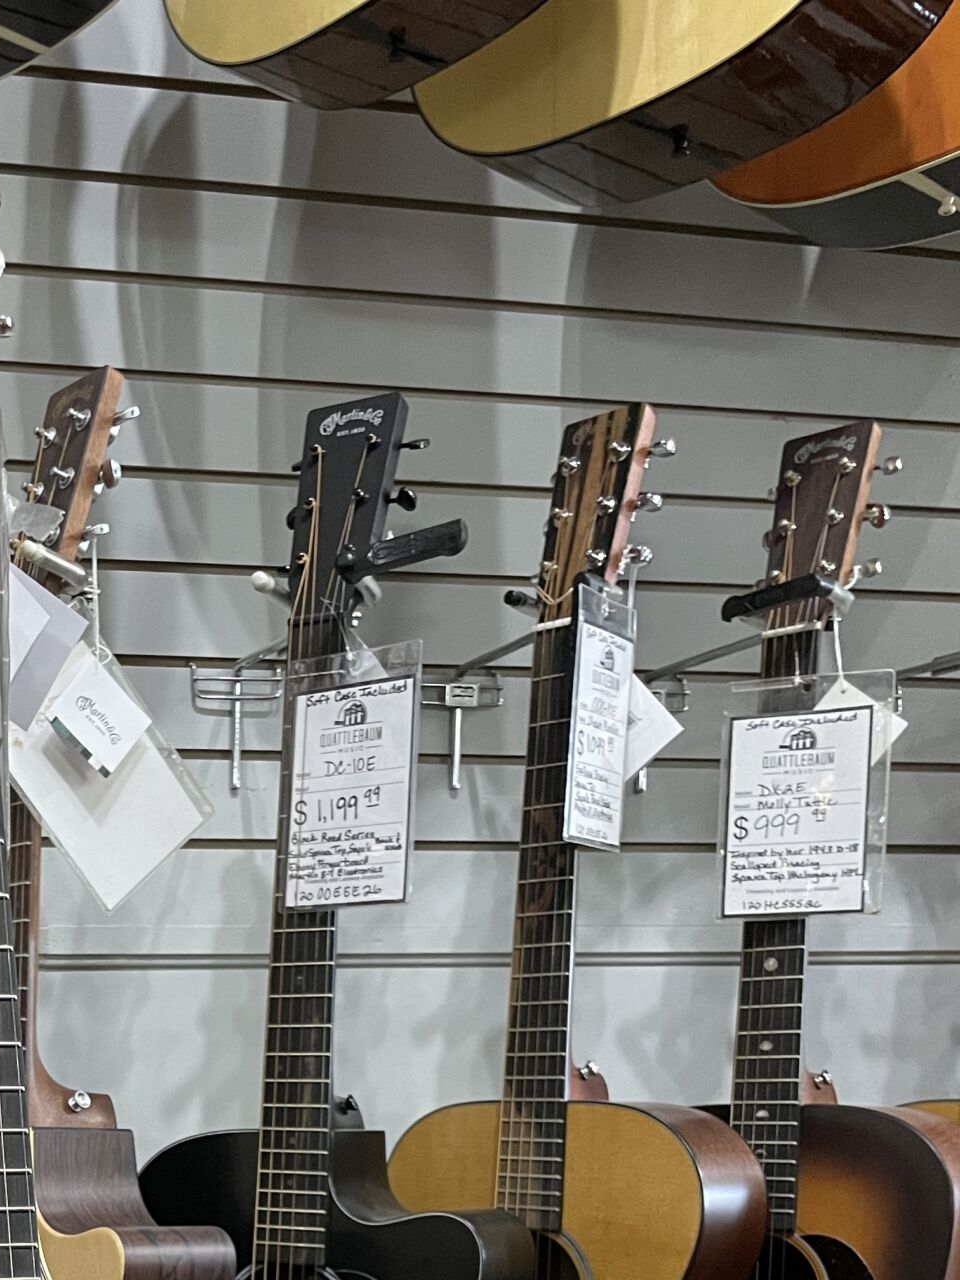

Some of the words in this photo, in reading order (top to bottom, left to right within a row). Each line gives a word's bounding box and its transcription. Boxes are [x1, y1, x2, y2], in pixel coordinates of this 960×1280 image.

[320, 726, 383, 748] QUATTLEBAUM
[323, 755, 376, 777] DC-10E
[762, 752, 835, 769] QUATTLEBAUM
